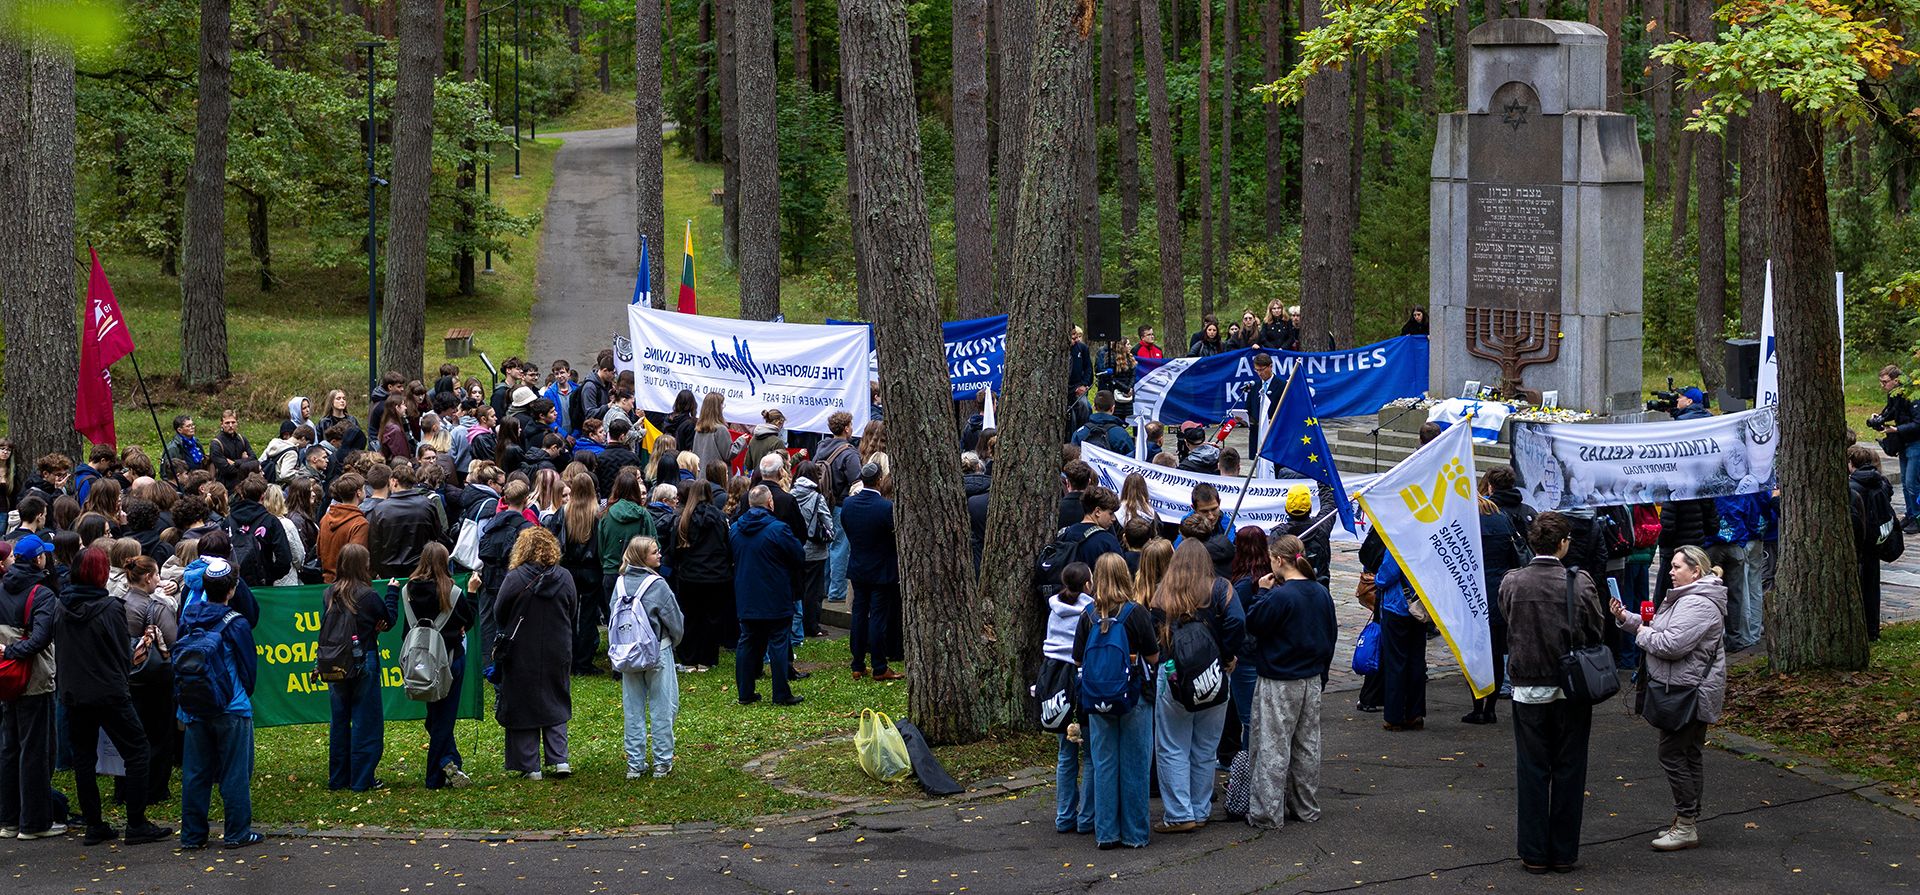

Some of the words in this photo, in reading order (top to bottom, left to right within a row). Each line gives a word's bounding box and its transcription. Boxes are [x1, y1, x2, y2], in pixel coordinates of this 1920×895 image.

[957, 380, 993, 392] MEMORY
[1438, 526, 1470, 573] SIMONO
[1449, 519, 1479, 572] VILNIAUS
[1429, 533, 1479, 619] PROGIMNAZIJA
[1193, 658, 1221, 698] NIKE
